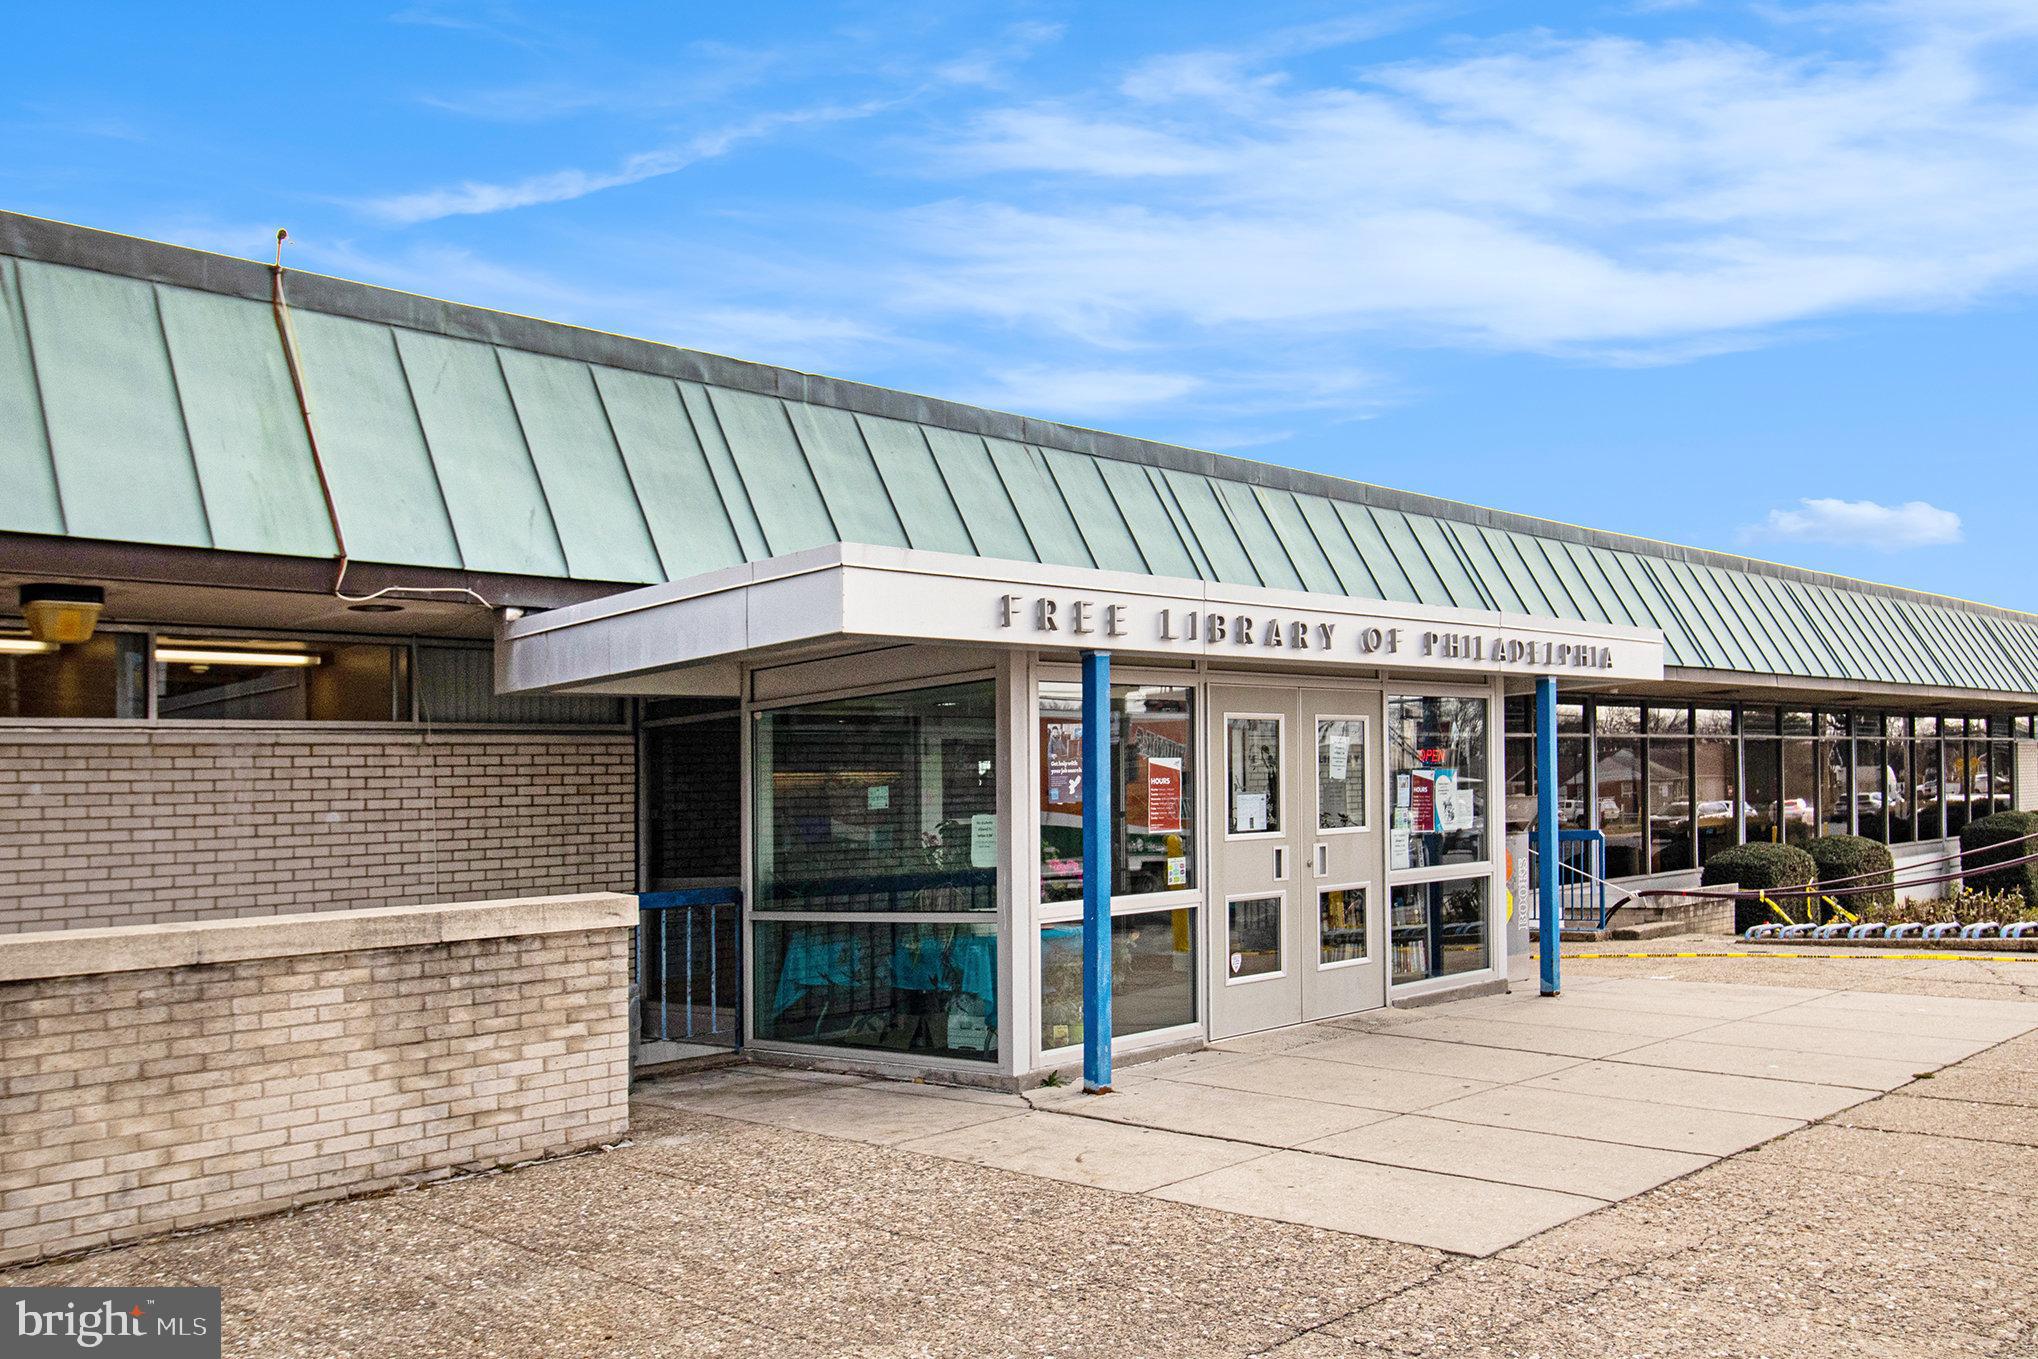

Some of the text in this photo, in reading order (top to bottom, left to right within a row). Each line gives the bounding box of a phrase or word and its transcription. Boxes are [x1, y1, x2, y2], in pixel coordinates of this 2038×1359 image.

[1001, 594, 1613, 669] FREE LIBRARY OF PHILADELPHIA
[1419, 749, 1446, 762] OPEN
